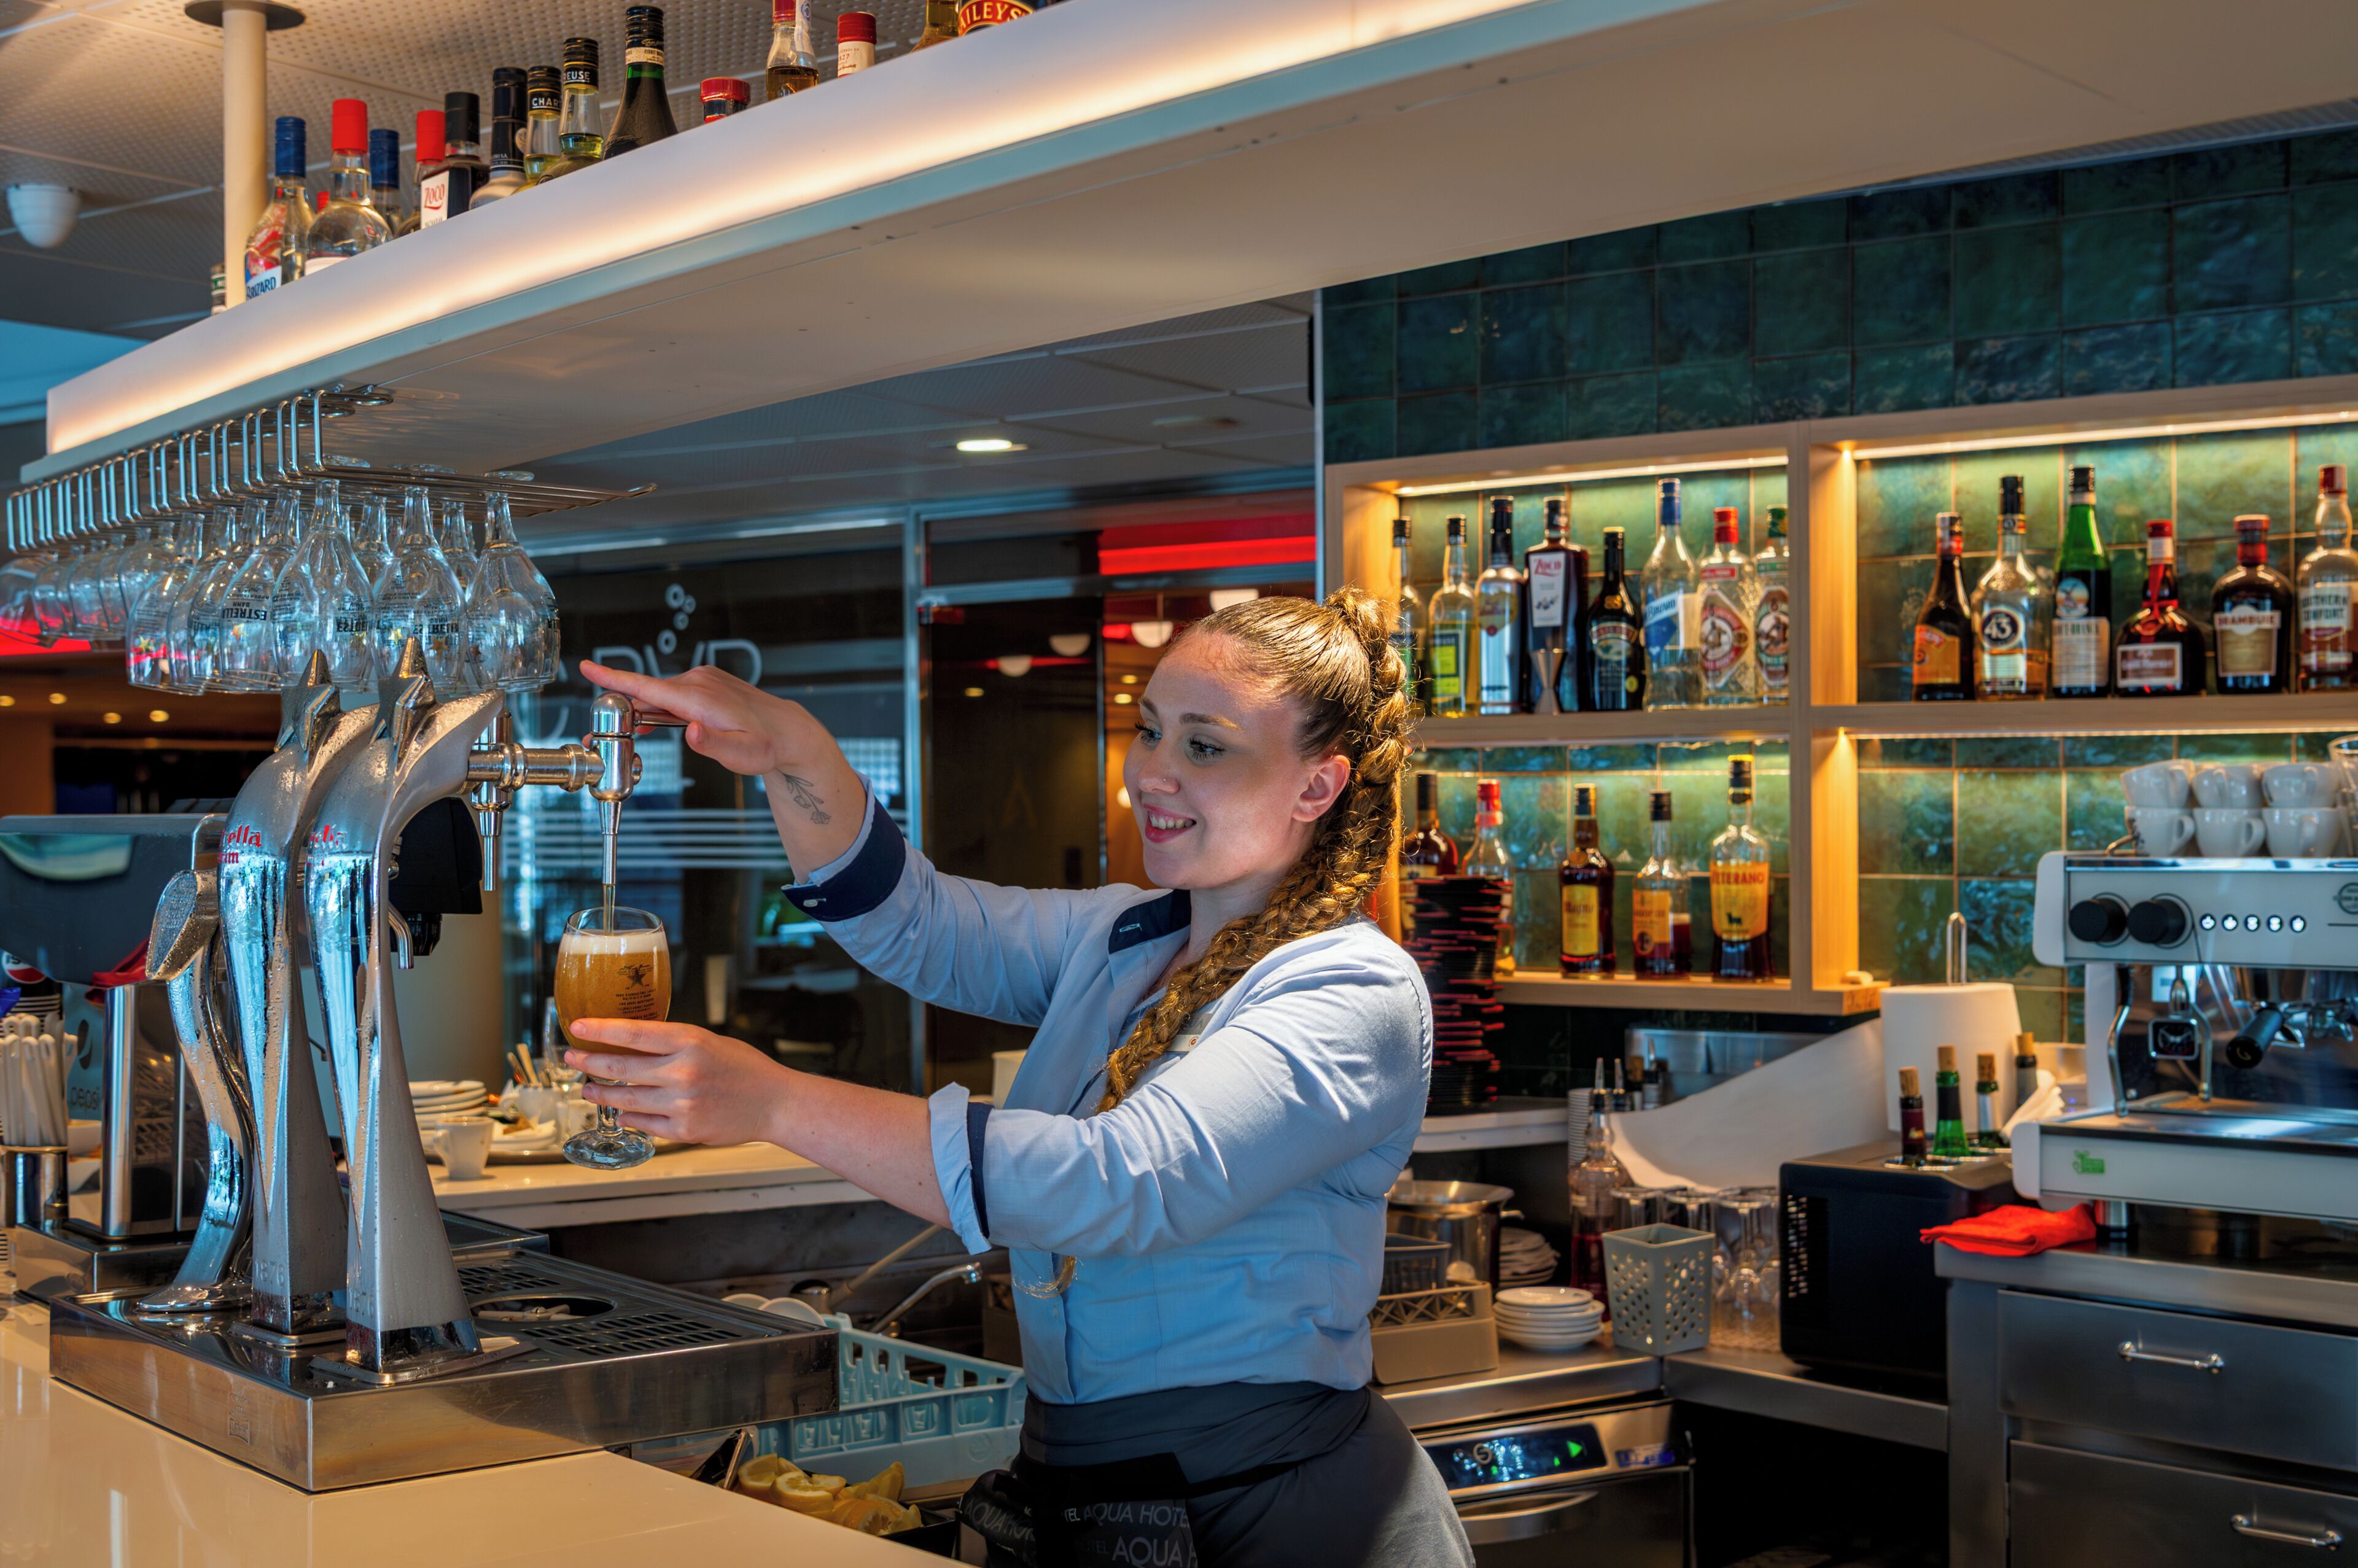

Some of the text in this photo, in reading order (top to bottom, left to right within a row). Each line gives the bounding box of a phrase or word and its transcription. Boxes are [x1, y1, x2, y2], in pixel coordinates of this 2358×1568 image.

[959, 1, 1022, 35] AILEYS
[425, 184, 445, 209] ZOCO
[1984, 618, 2012, 639] 43
[1061, 1502, 1191, 1528] TEL AQUA HOTE
[1111, 1535, 1183, 1568] AQUA
